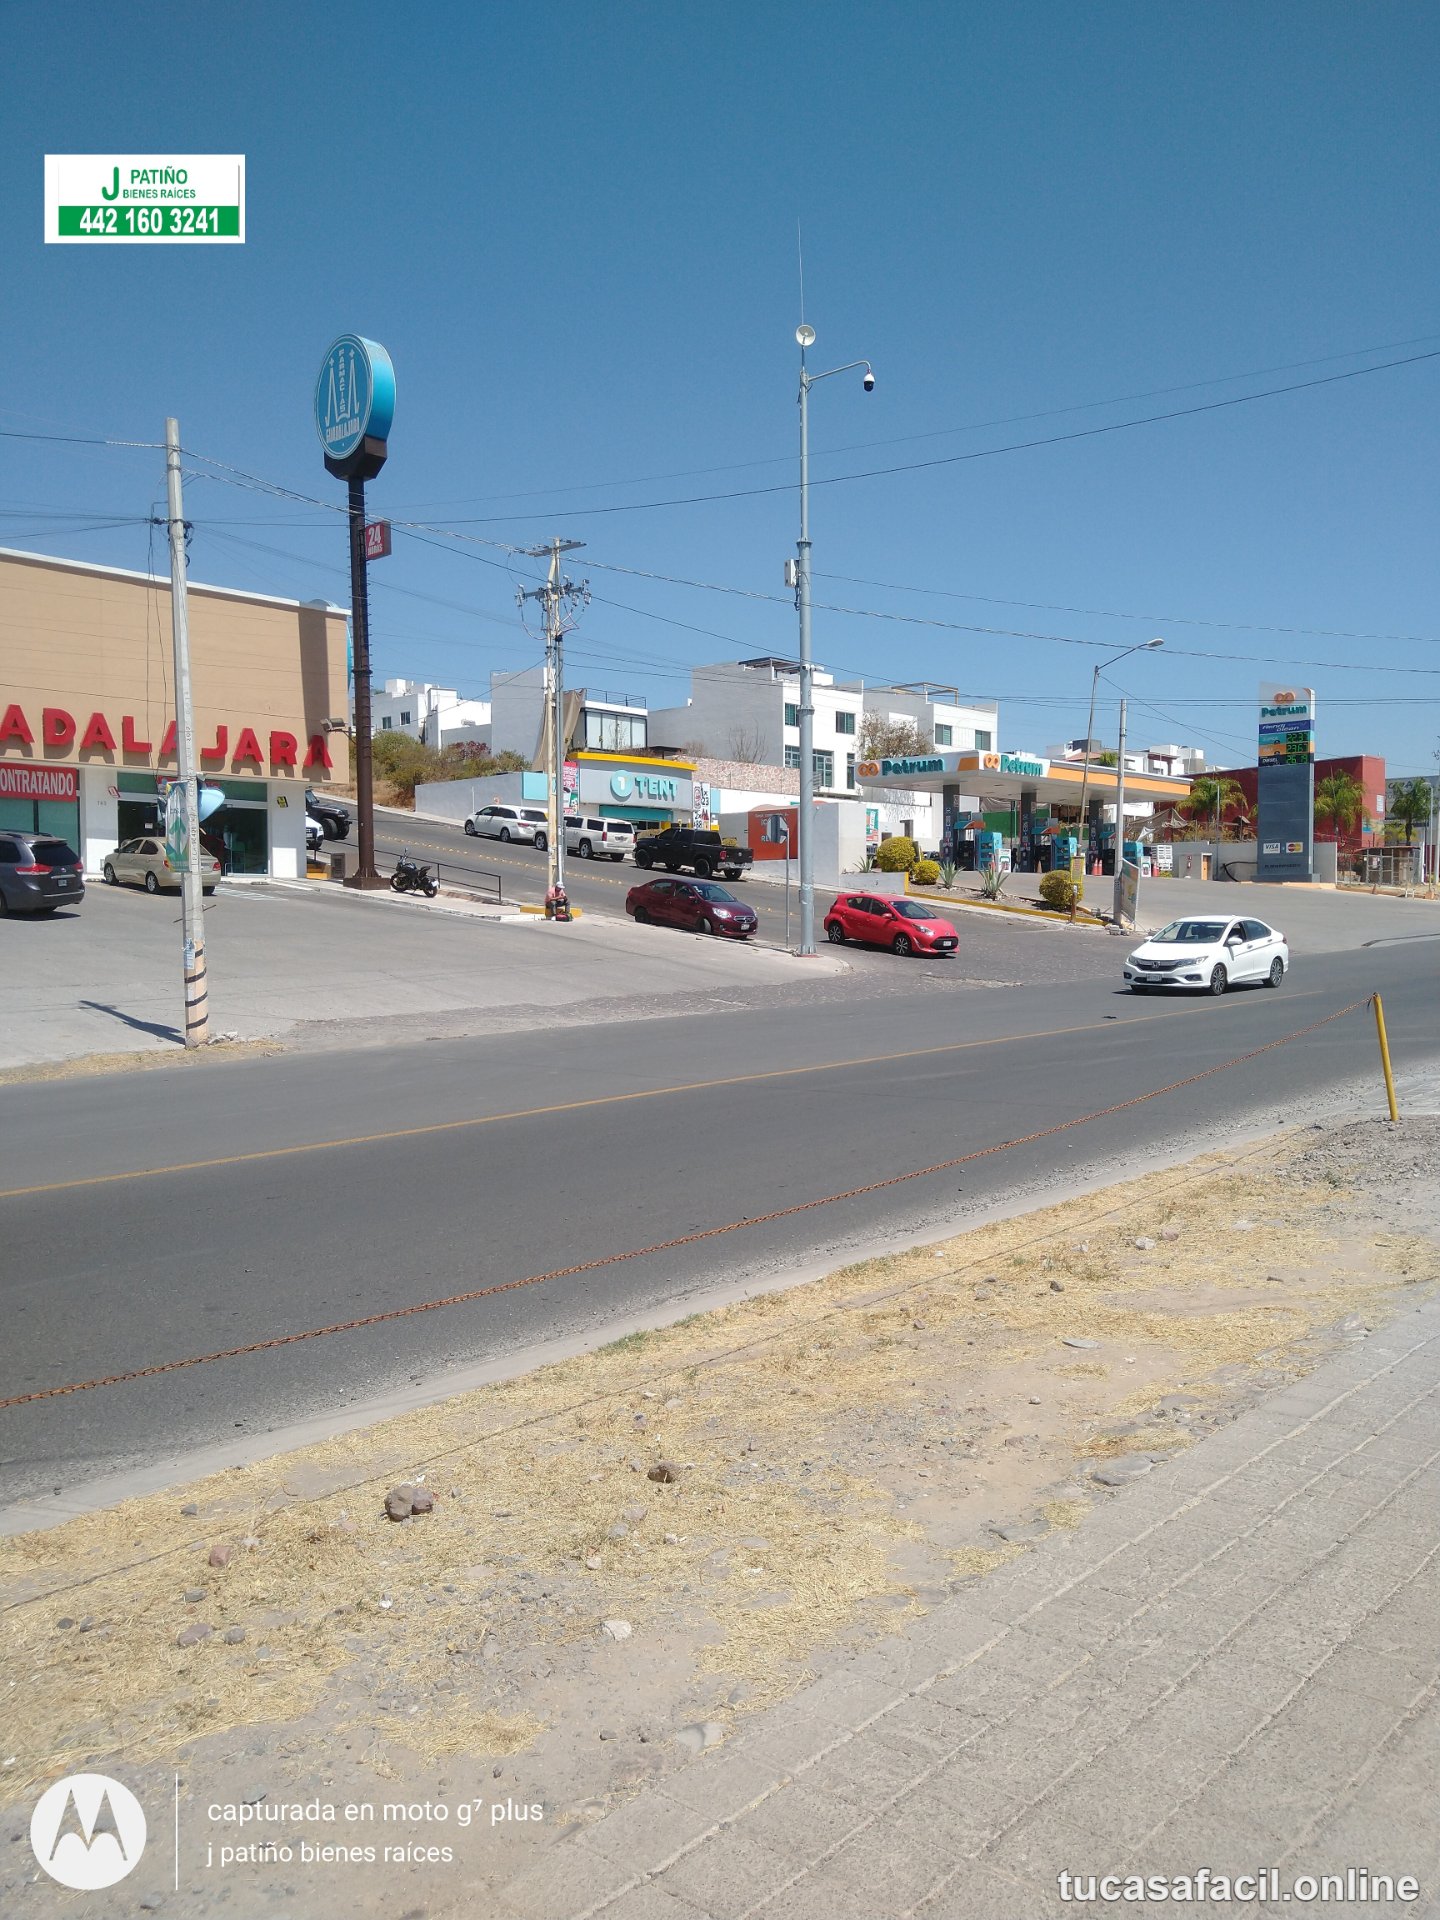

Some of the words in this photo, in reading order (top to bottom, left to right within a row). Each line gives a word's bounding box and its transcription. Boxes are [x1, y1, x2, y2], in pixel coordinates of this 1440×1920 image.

[338, 348, 346, 413] FARMACIAS
[368, 525, 381, 546] 24
[1261, 705, 1308, 718] Petrum
[882, 757, 944, 776] Petrum
[1000, 754, 1043, 777] Petrum
[0, 767, 74, 796] ONTRATANDO
